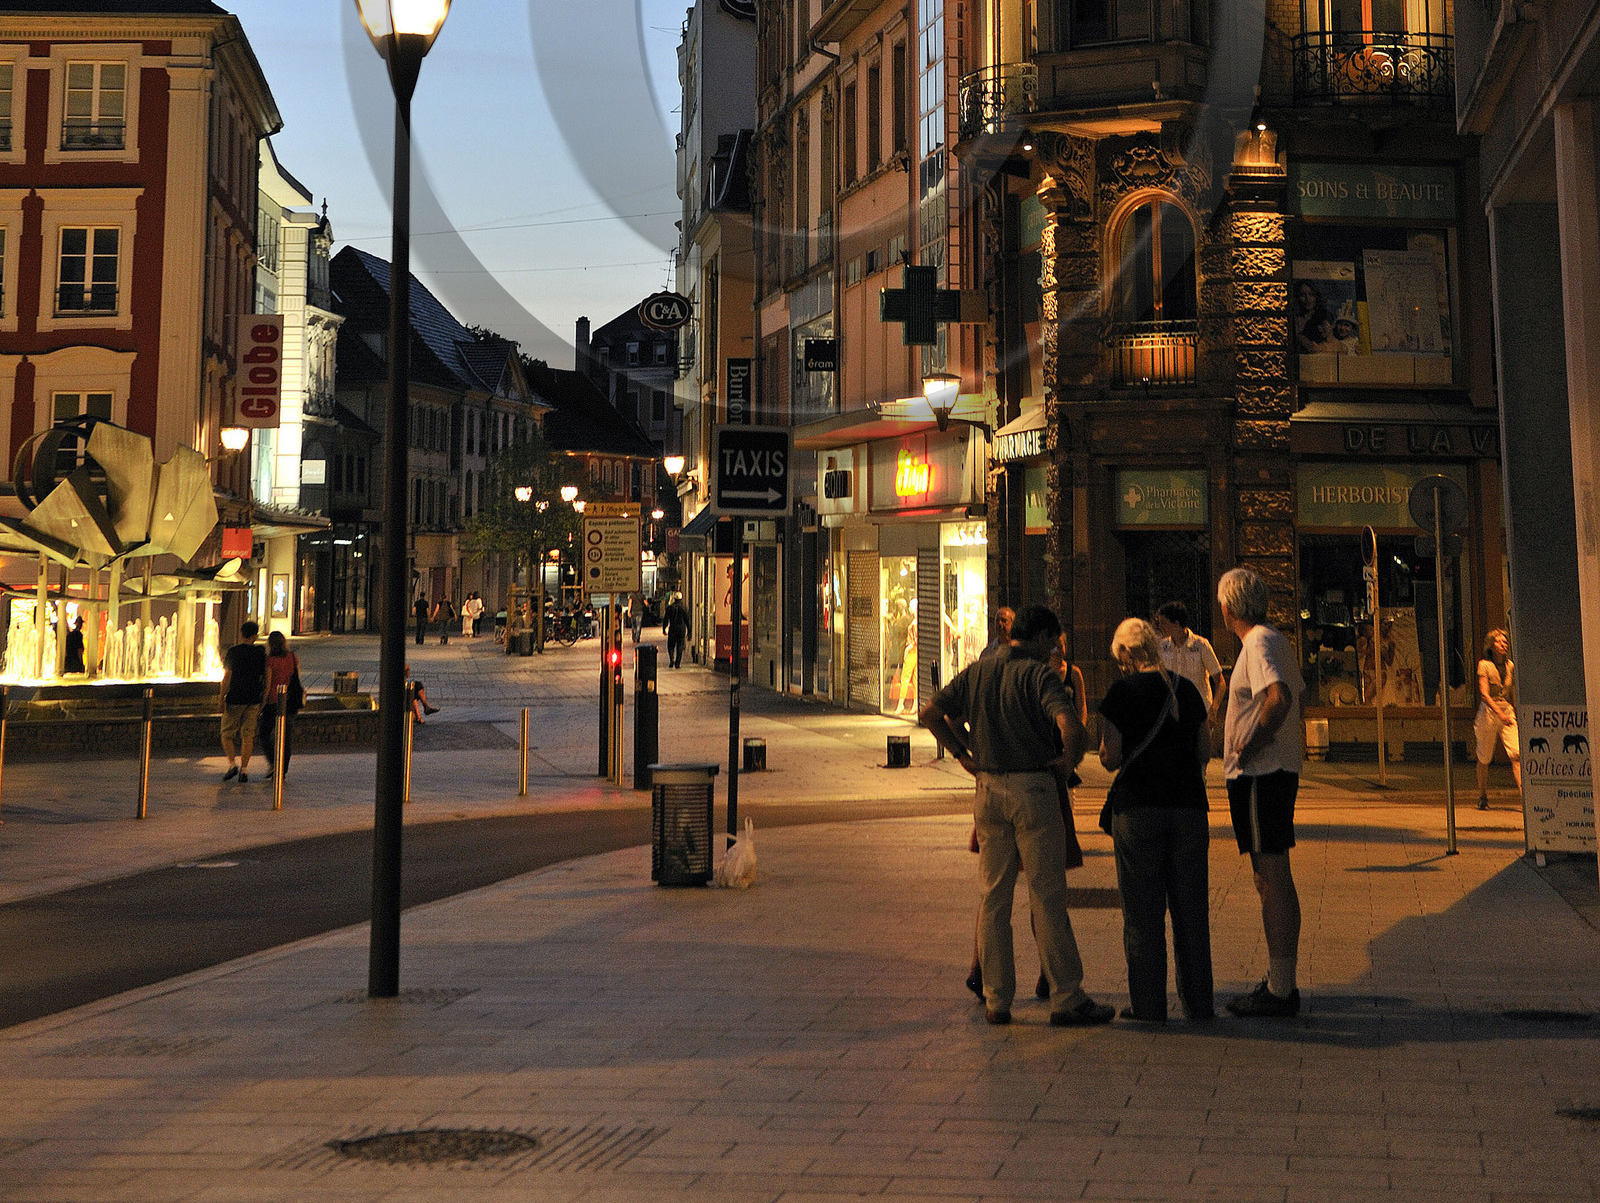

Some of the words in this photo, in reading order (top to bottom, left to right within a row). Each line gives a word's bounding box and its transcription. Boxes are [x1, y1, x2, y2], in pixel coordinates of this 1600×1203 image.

[1297, 180, 1349, 198] SOINS
[650, 302, 683, 320] C&A
[241, 324, 279, 418] Globe
[1344, 426, 1388, 451] DE
[1407, 427, 1451, 452] LA
[722, 449, 784, 478] TAXIS
[1146, 486, 1200, 497] Pharmacie
[1160, 498, 1200, 510] Victoire
[223, 549, 249, 558] orange
